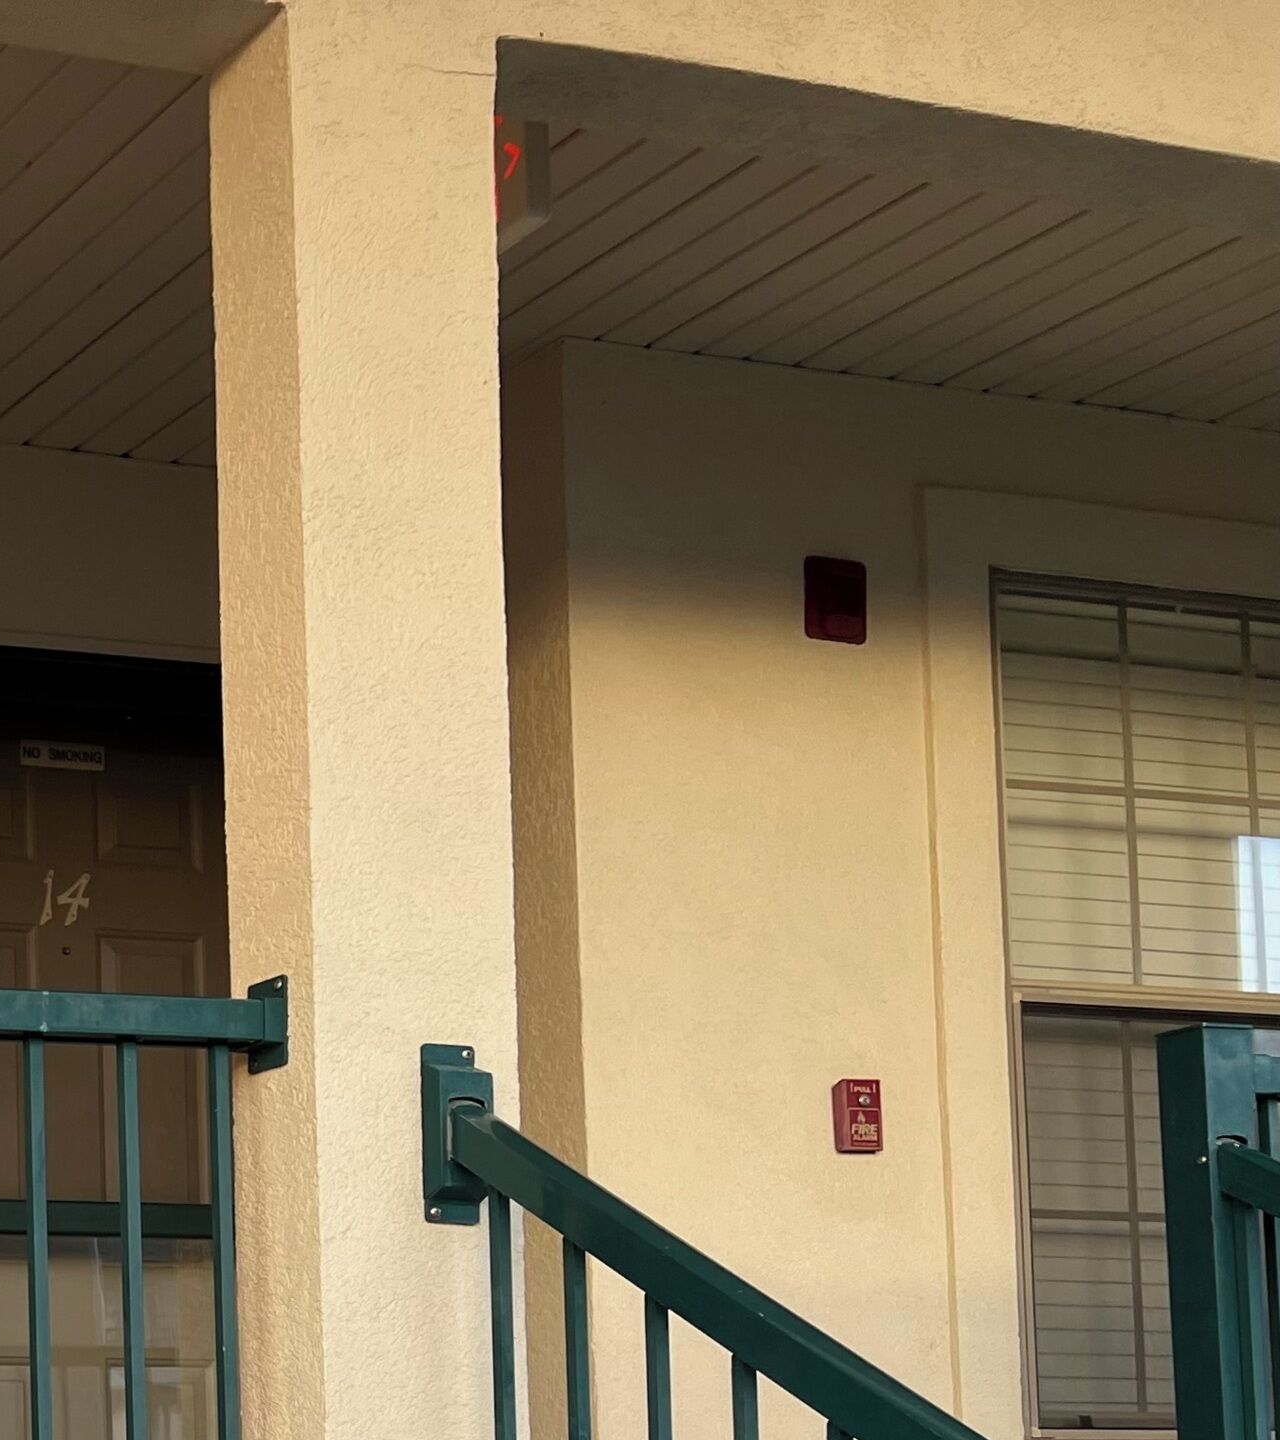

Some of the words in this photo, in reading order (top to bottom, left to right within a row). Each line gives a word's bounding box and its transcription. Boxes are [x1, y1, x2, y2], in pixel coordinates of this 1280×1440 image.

[22, 746, 41, 759] NO
[48, 747, 102, 764] SMOKING
[39, 869, 91, 927] 14
[851, 1123, 878, 1135] FIRE
